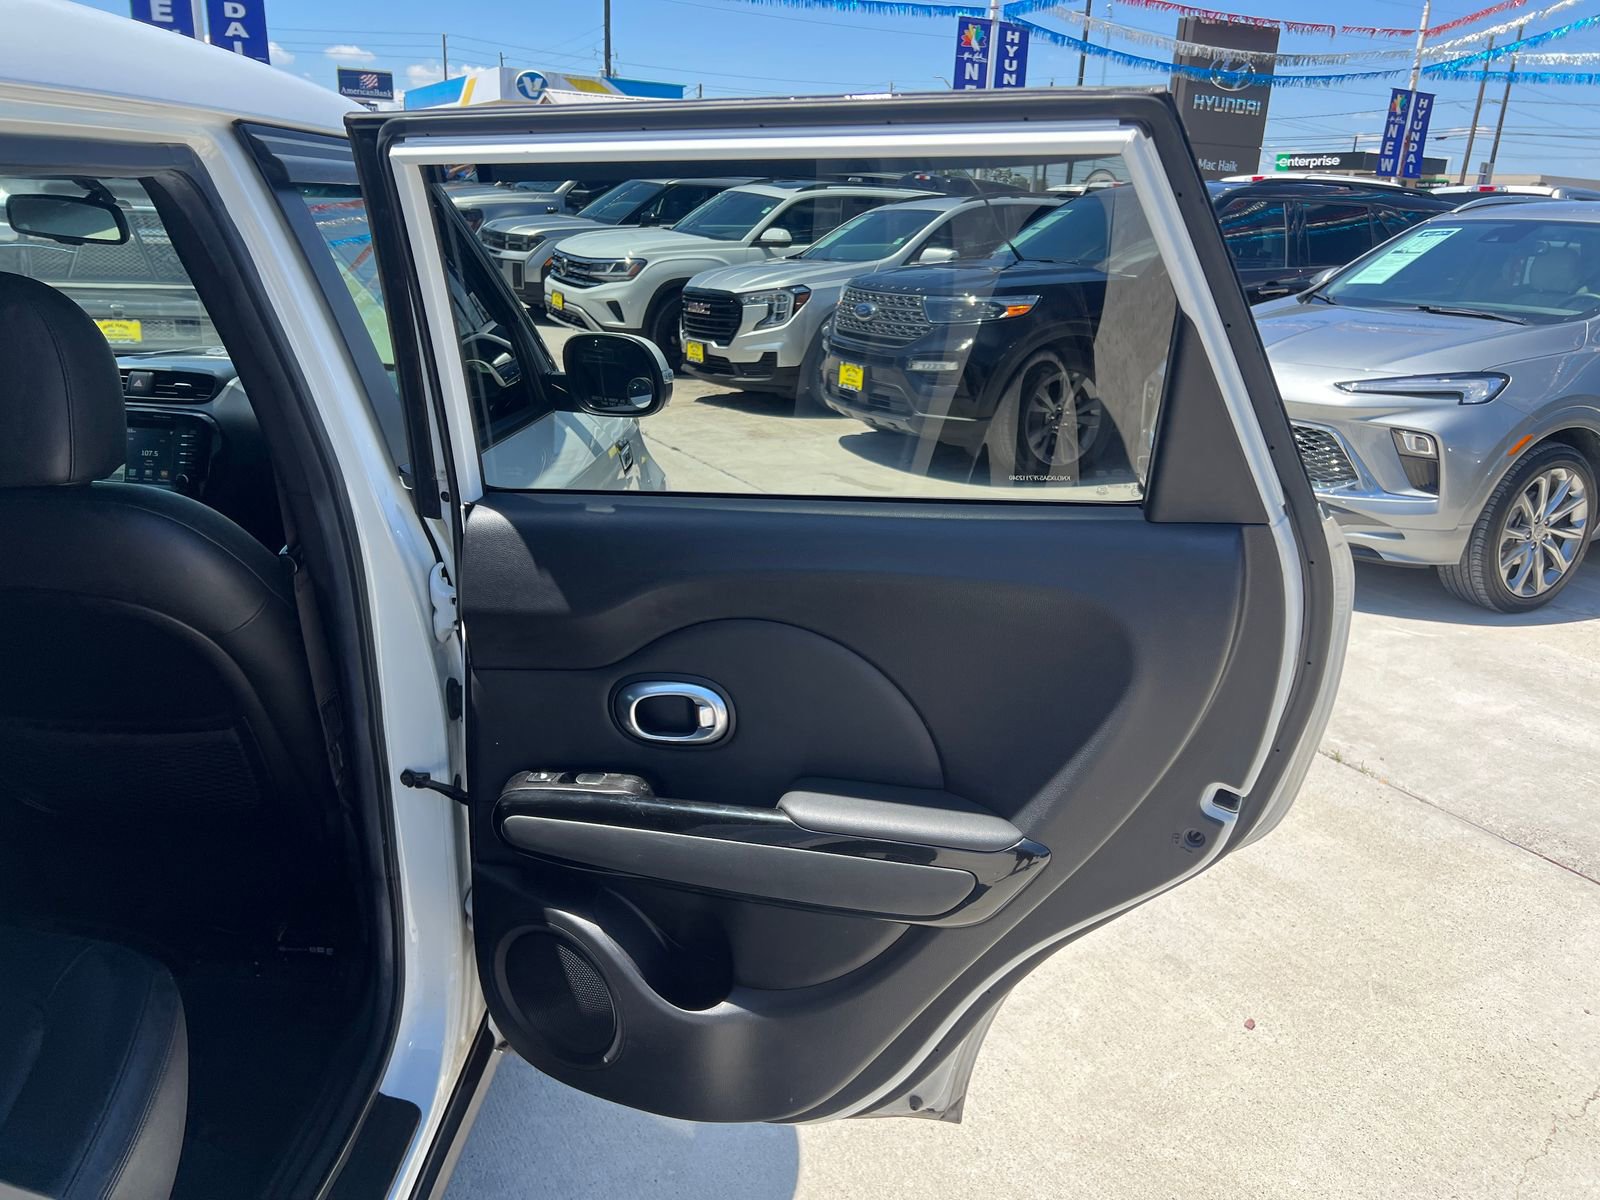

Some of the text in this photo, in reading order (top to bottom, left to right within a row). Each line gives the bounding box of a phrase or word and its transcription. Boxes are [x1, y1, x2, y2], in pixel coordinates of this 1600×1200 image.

[1003, 31, 1020, 88] HYUN
[1193, 94, 1261, 116] HYUNDAI
[1407, 98, 1429, 174] HYUNDAI
[1381, 124, 1398, 172] NEW
[1198, 158, 1238, 172] Mac Haik
[1278, 155, 1341, 169] enterprise
[141, 449, 158, 457] 107.5
